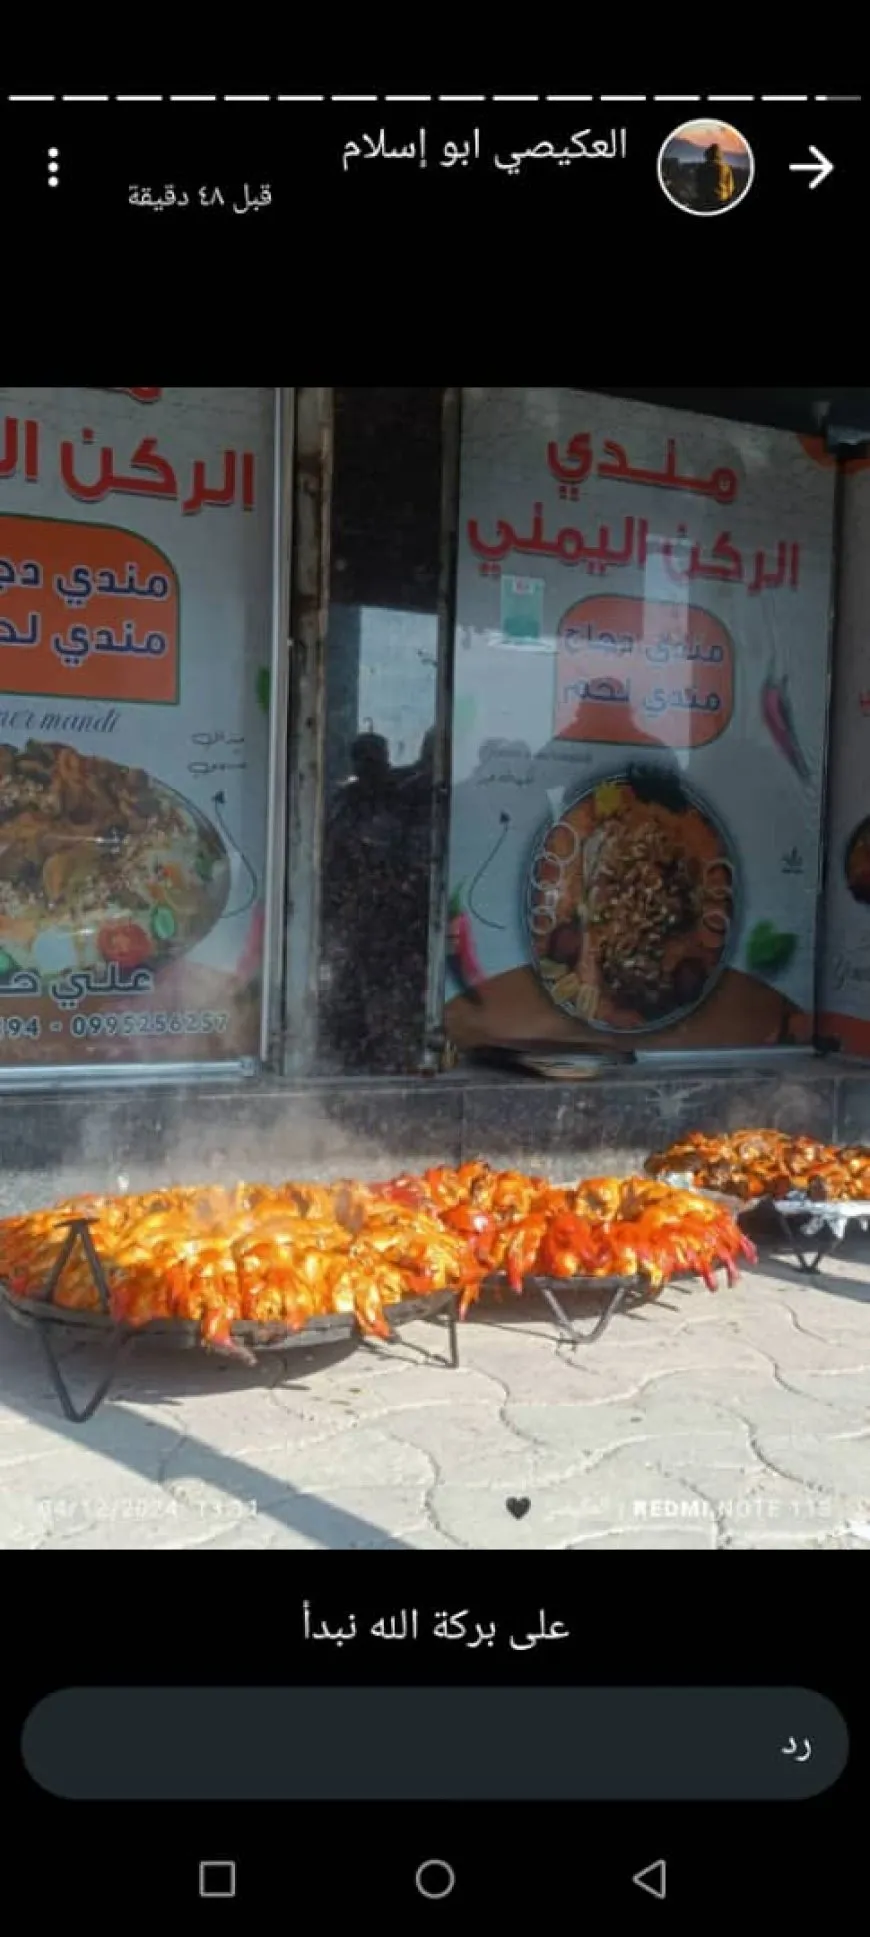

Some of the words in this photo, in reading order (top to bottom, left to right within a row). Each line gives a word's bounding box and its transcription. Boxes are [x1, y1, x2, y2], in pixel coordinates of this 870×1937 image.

[61, 427, 256, 517] الركن
[547, 431, 738, 504] مندي
[466, 502, 649, 578] اليمني
[661, 523, 800, 598] الركن
[55, 561, 169, 606] مندي
[53, 621, 167, 667] مندي
[644, 631, 724, 666] مندي
[561, 674, 632, 704] لحم
[641, 686, 721, 717] مندي
[38, 706, 121, 734] mandi
[49, 960, 154, 1011] علي
